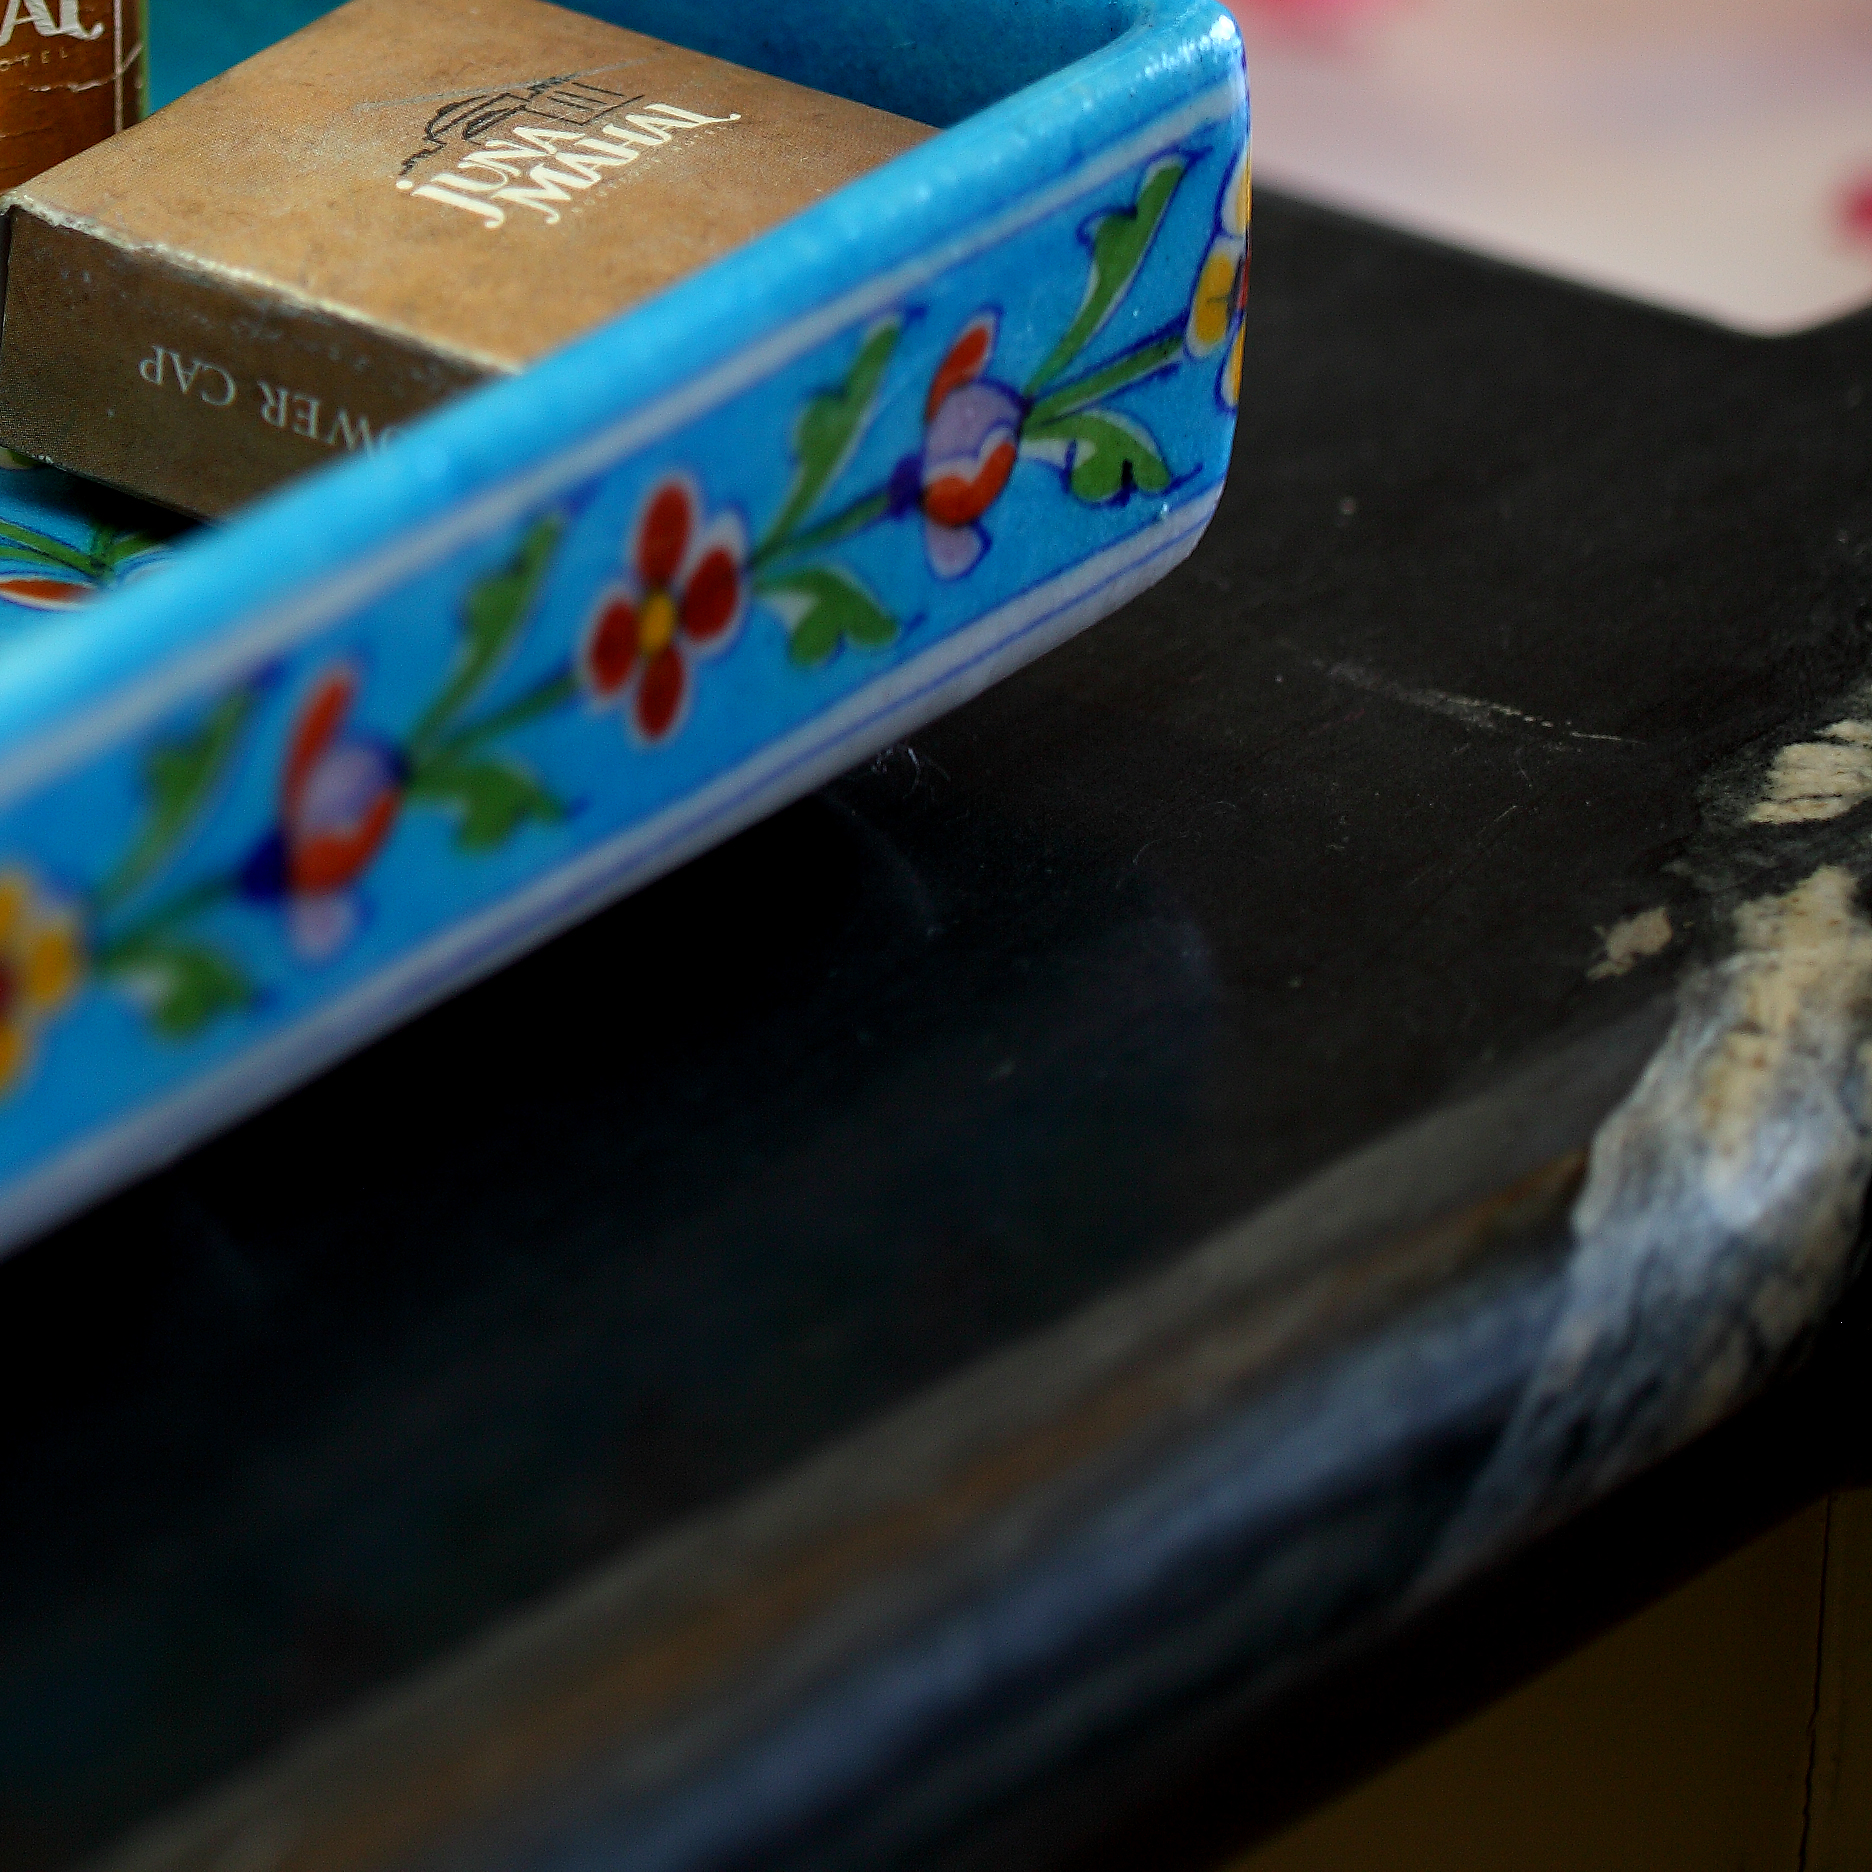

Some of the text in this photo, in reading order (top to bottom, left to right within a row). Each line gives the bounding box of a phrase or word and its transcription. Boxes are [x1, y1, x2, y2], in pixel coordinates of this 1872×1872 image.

[490, 102, 742, 225] MAHAL
[138, 343, 399, 460] WER CAP
